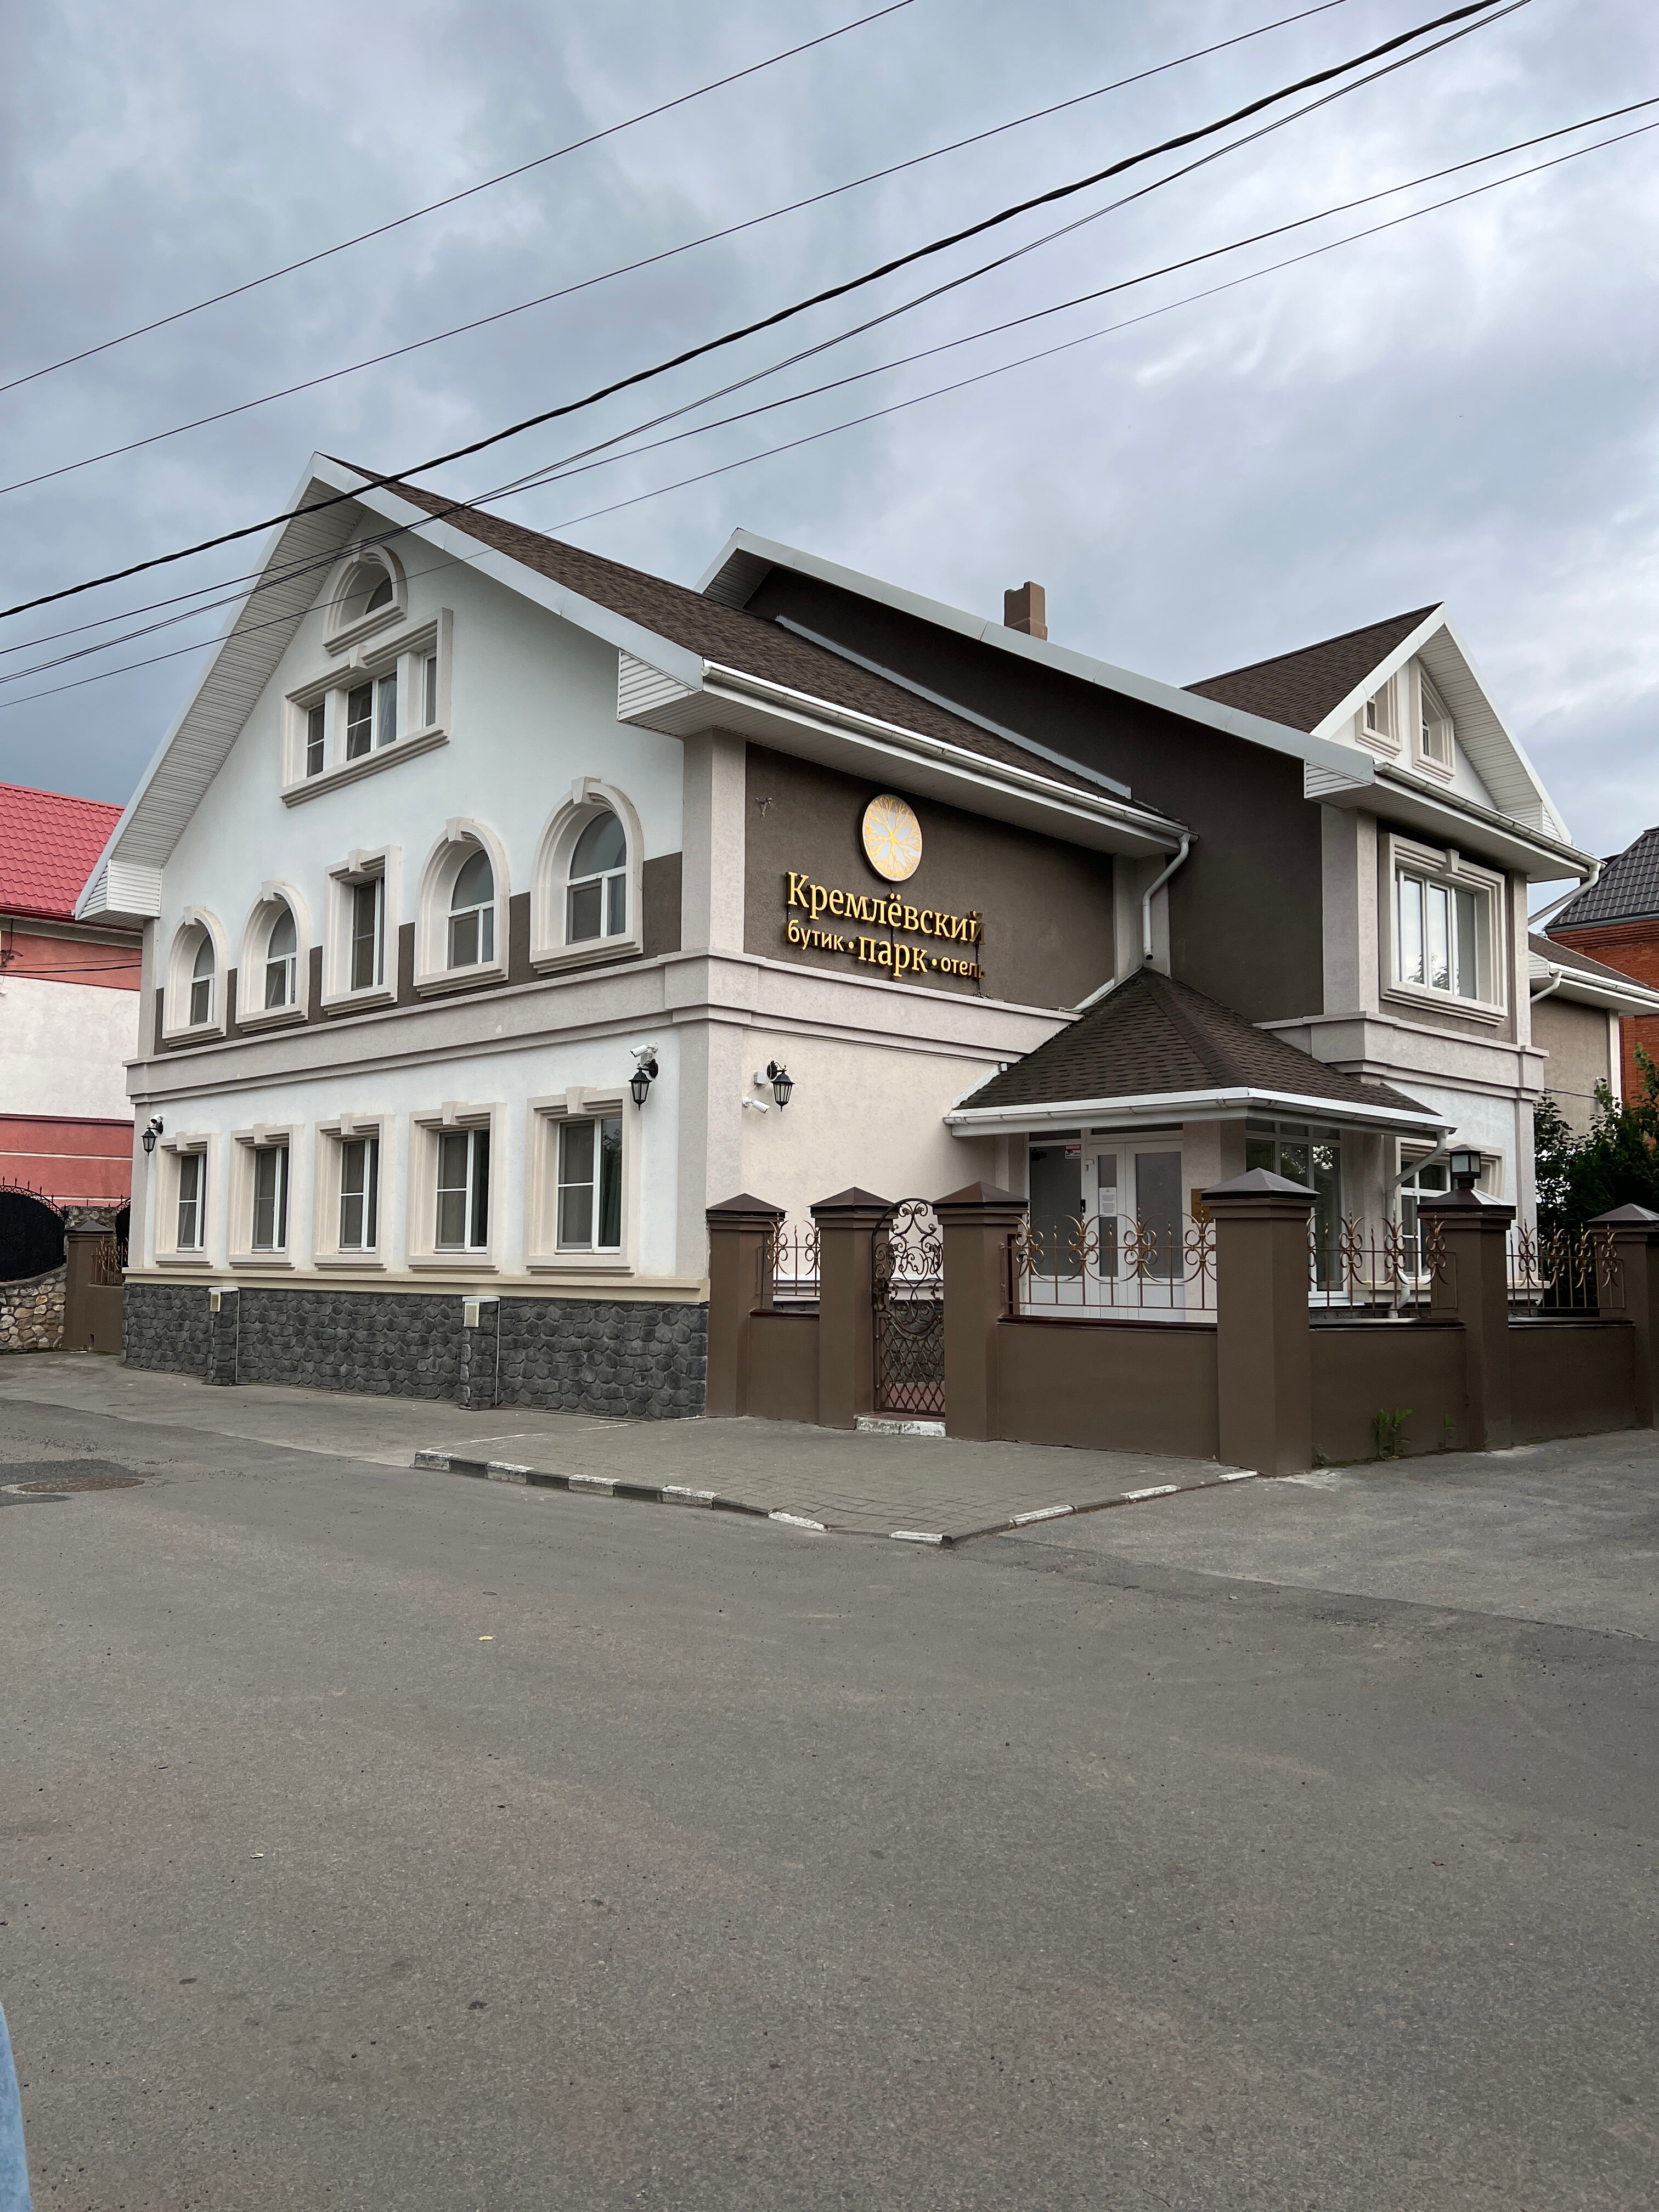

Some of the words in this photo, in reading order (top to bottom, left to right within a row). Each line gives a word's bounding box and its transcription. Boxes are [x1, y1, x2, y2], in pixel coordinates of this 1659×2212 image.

[787, 871, 986, 945] Кремлёвский
[788, 919, 844, 951] бутик
[858, 936, 928, 977] парк
[941, 957, 986, 979] отель
